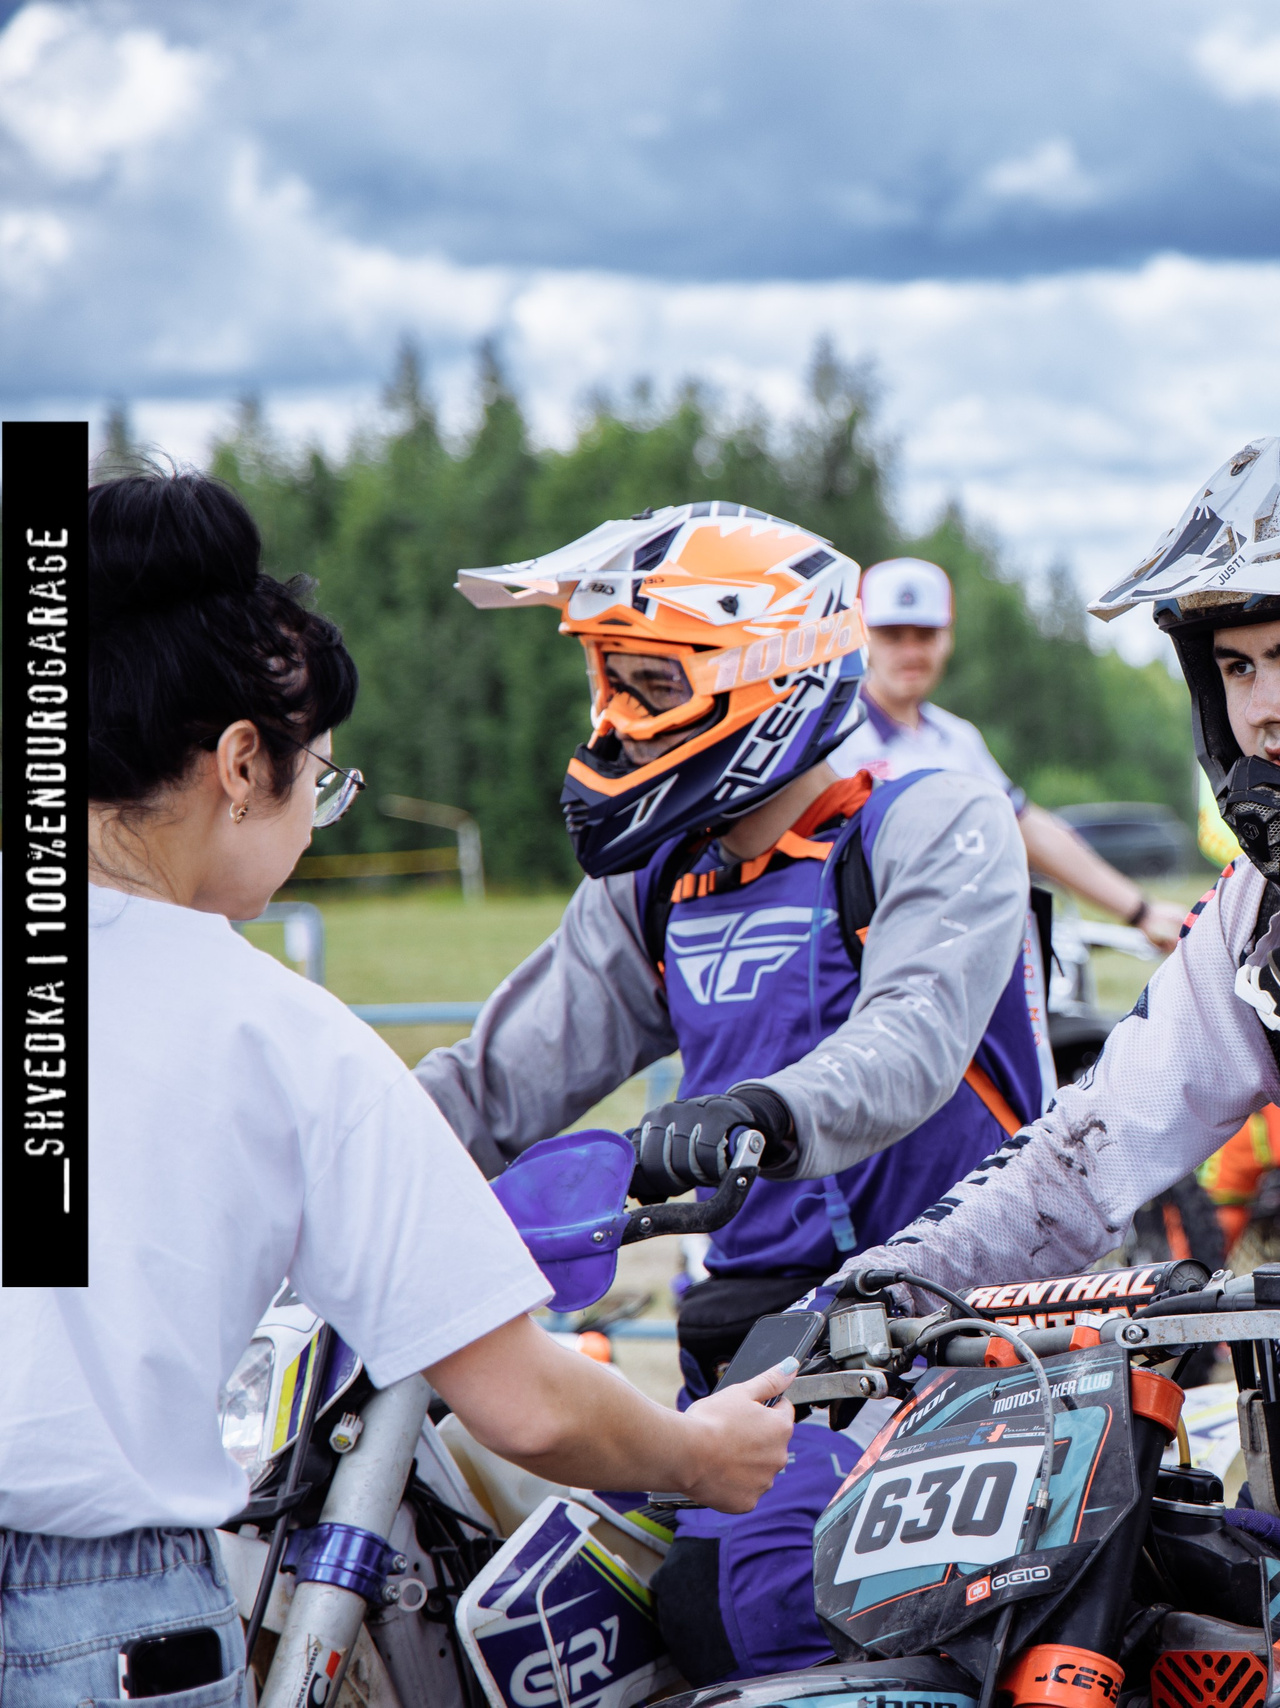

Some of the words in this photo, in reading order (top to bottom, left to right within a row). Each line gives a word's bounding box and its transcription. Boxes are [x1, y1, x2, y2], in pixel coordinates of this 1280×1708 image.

[1218, 554, 1246, 586] JUST1
[707, 615, 853, 692] 100%
[964, 1268, 1157, 1309] RENTHAL
[897, 1382, 956, 1439] thor
[992, 1379, 1078, 1415] MOTOSTKER
[1079, 1372, 1111, 1393] CLUB
[854, 1461, 1018, 1555] 630
[992, 1565, 1051, 1591] OGIO
